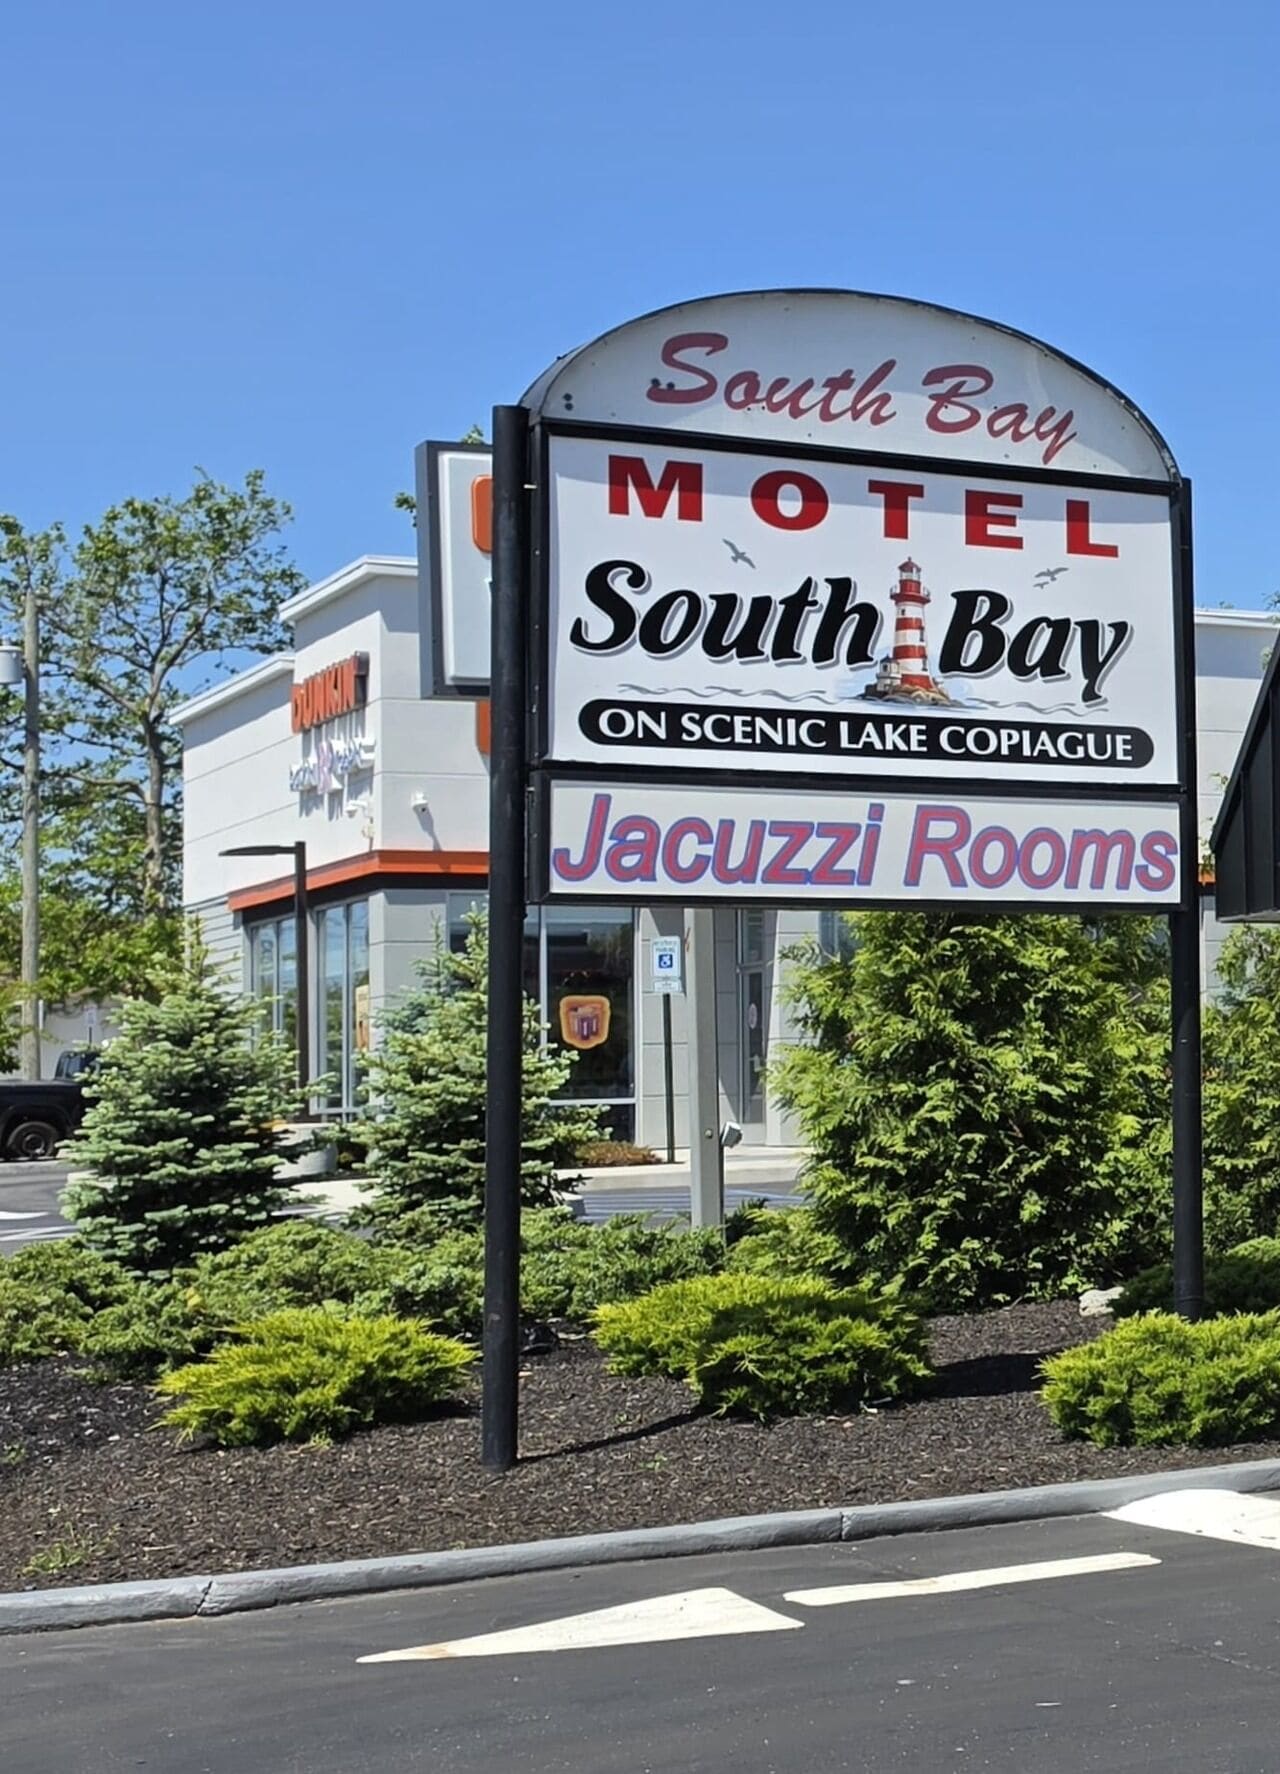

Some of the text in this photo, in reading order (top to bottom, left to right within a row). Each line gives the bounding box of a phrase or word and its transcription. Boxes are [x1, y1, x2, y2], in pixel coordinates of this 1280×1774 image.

[646, 332, 1077, 464] South Bay
[608, 455, 1119, 558] MOTEL
[570, 560, 1134, 703] South Bay
[598, 708, 1133, 761] ON SCENIC LAKE COPIAGUE
[553, 793, 1177, 892] Jacuzzi Rooms
